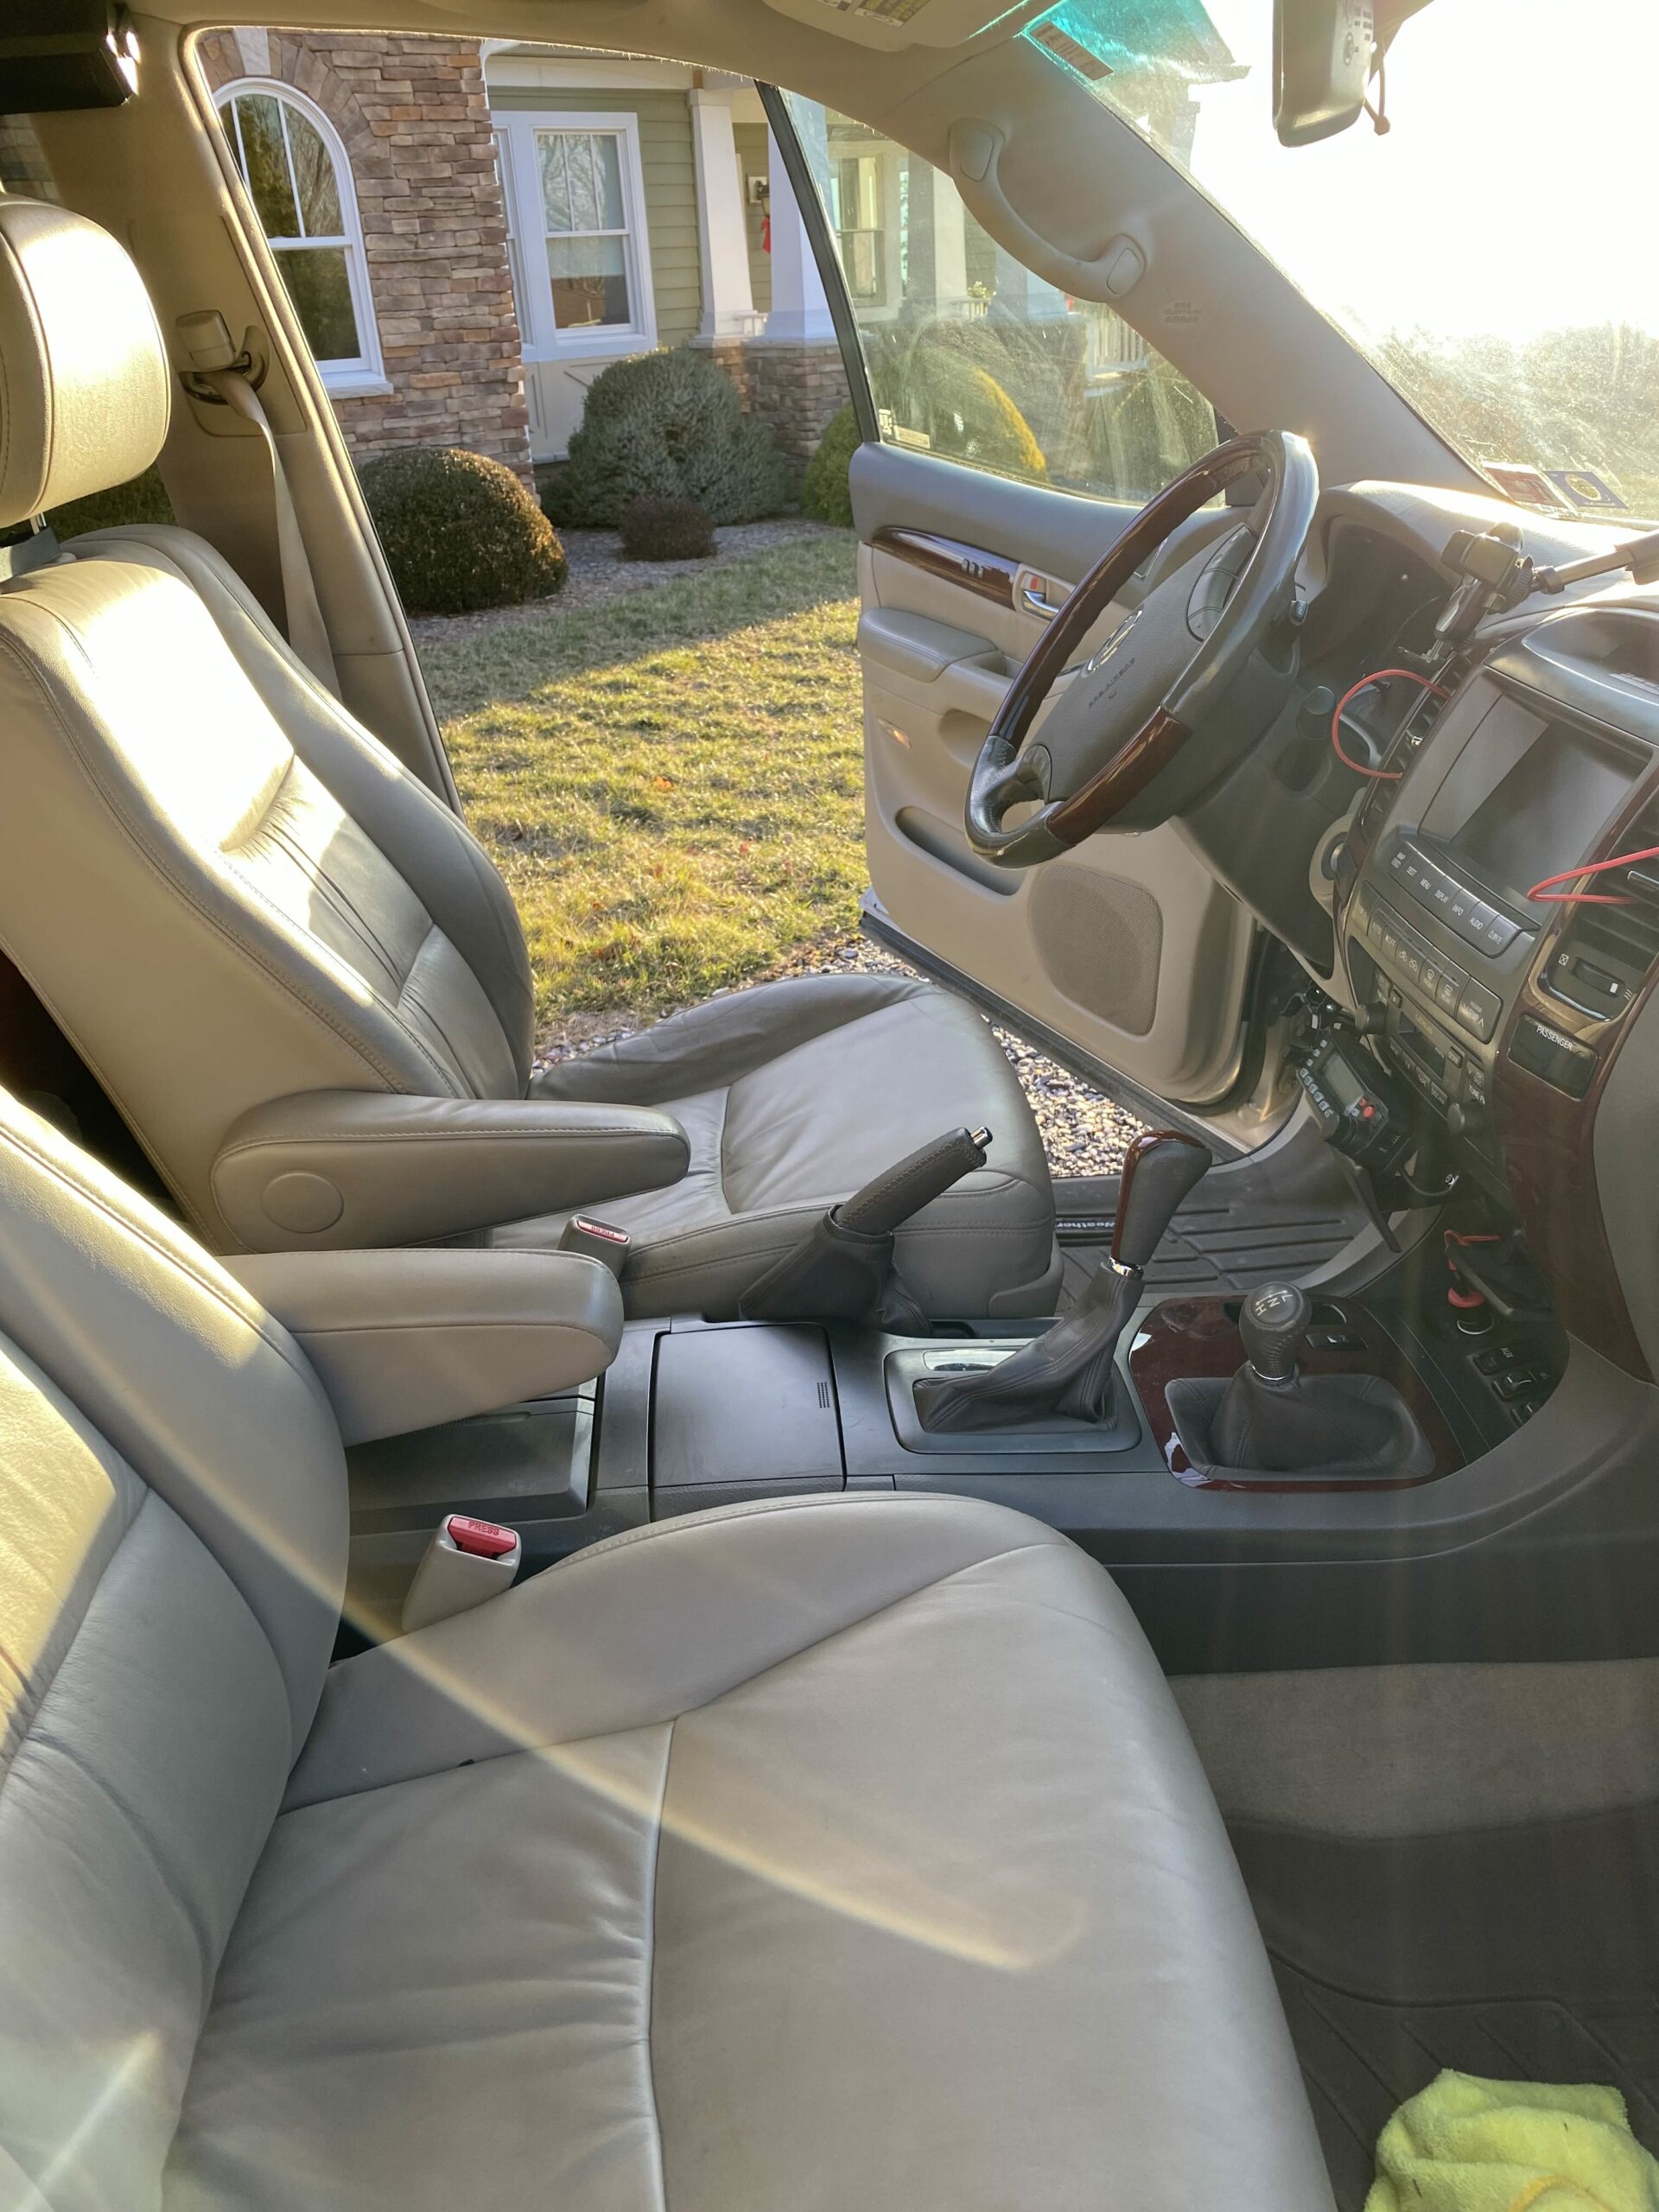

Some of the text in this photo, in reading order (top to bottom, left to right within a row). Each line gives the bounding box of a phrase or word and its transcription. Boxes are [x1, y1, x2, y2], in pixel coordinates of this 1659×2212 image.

[1406, 866, 1417, 876] DEST
[1420, 878, 1432, 890] MENU
[1434, 889, 1449, 903] DISPLAY
[1452, 904, 1464, 916] INFO
[1470, 917, 1484, 930] AUDIO
[1535, 1025, 1573, 1051] PASSENGER
[1255, 1303, 1267, 1316] H
[1267, 1297, 1281, 1308] N
[1500, 1347, 1515, 1359] AUX
[467, 1520, 500, 1536] PRESS
